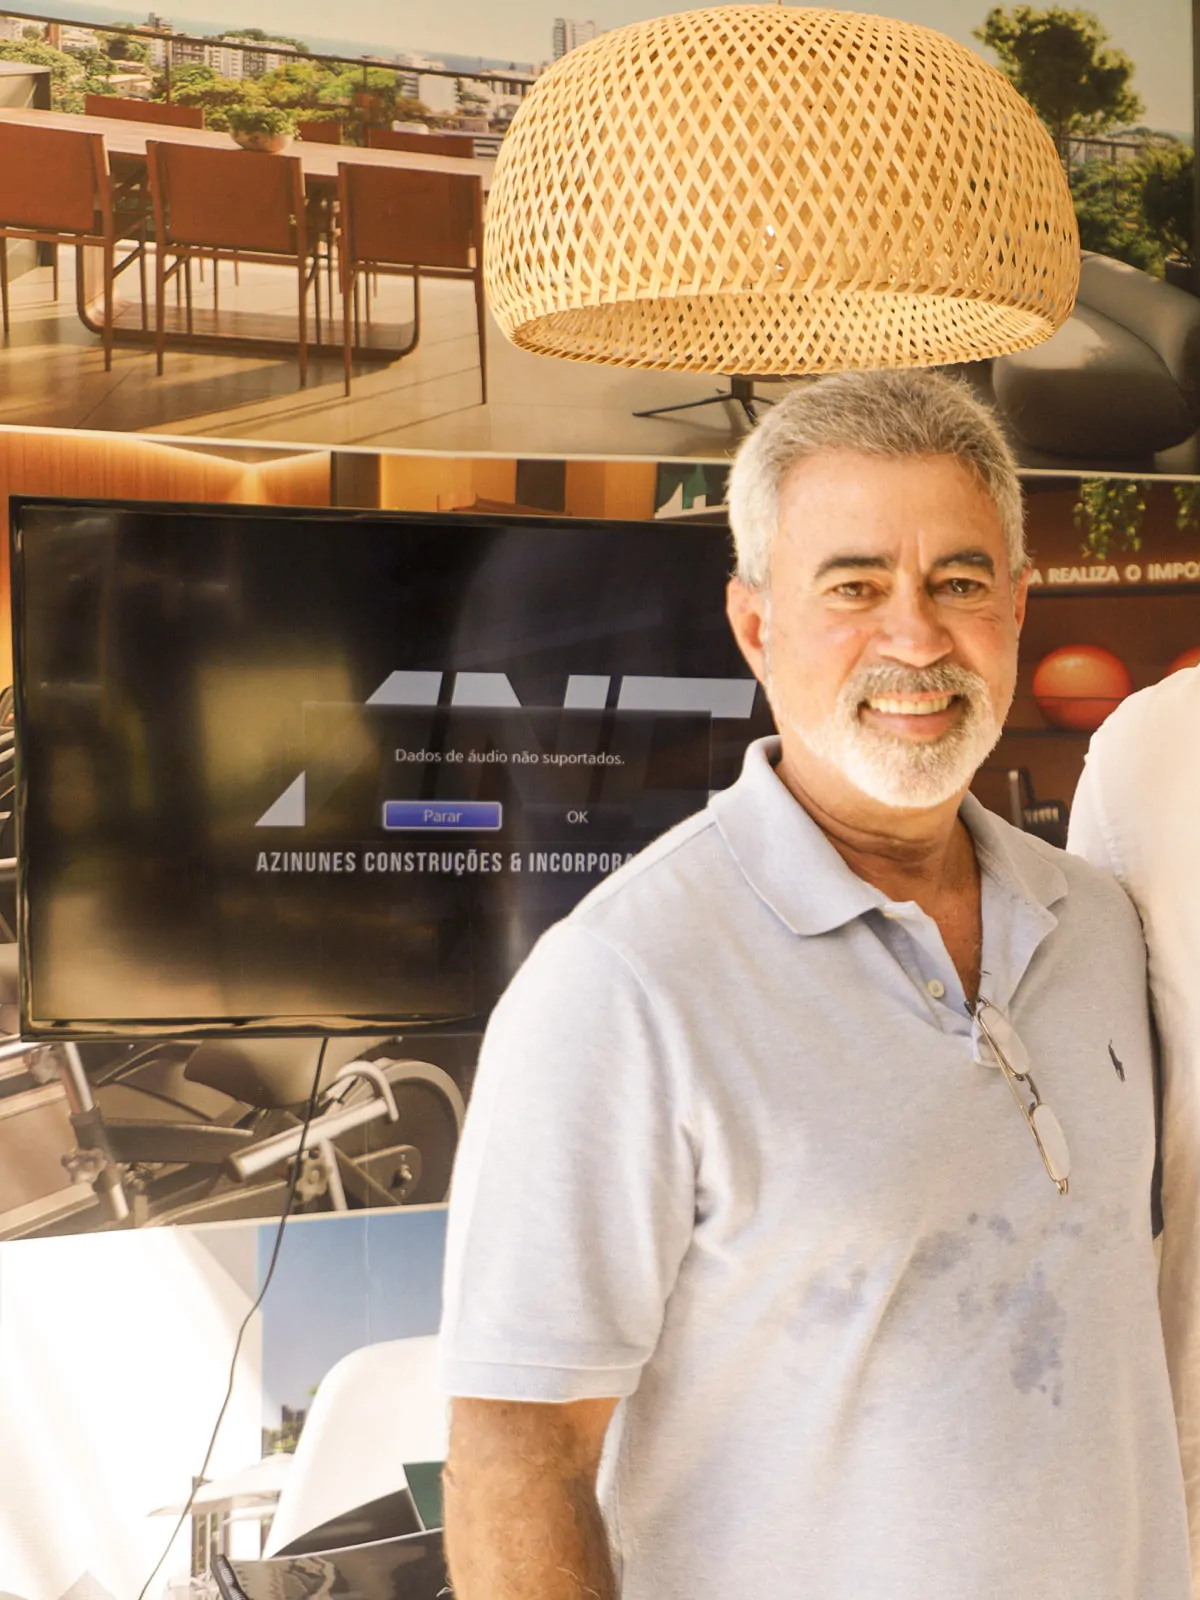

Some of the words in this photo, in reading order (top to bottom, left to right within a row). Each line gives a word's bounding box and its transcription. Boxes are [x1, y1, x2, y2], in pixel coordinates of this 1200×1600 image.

[1048, 565, 1120, 583] REALIZA
[1125, 564, 1142, 581] O
[395, 749, 441, 763] Dados
[446, 749, 464, 763] de
[468, 749, 508, 764] áudio
[512, 751, 539, 764] não
[542, 752, 625, 767] suportados.
[424, 809, 463, 823] Parar
[566, 811, 589, 824] OK
[256, 852, 356, 873] AZINUNES
[364, 849, 502, 876] CONSTRUÇÕES
[510, 852, 521, 872] &
